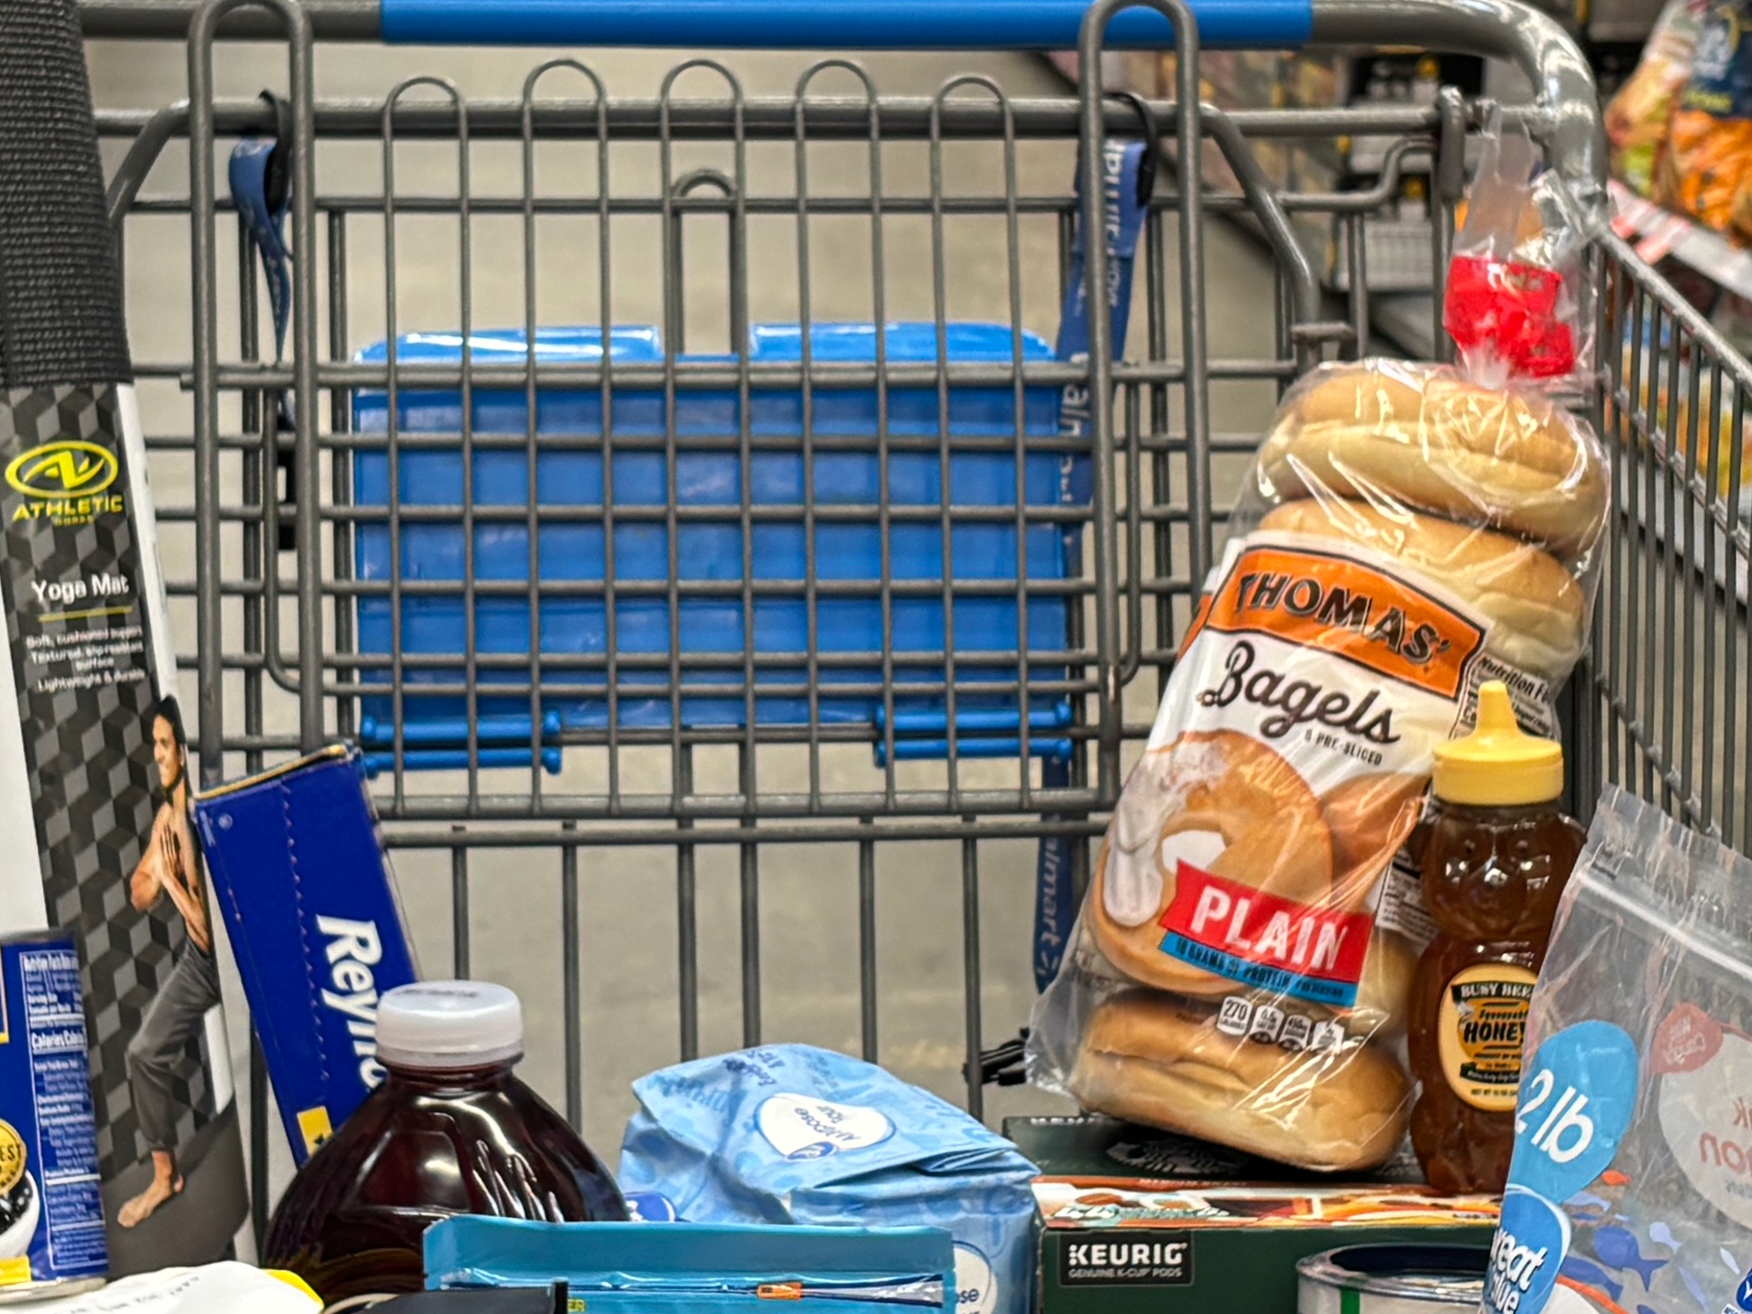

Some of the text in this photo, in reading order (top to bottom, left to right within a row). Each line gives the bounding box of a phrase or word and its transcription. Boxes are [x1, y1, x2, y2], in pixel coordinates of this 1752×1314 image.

[11, 494, 124, 524] ATHLETIC
[31, 572, 130, 605] Yoga Mat
[1235, 569, 1455, 672] THOMAS'
[1200, 641, 1401, 746] Bagels
[1480, 656, 1536, 698] Nutrition
[1315, 730, 1383, 768] PRE-SLICED
[1190, 885, 1350, 972] PLAIN
[1223, 998, 1249, 1021] 270
[1463, 1021, 1526, 1044] HONEY
[1533, 1078, 1595, 1164] lb
[1067, 1240, 1186, 1268] KEURIG
